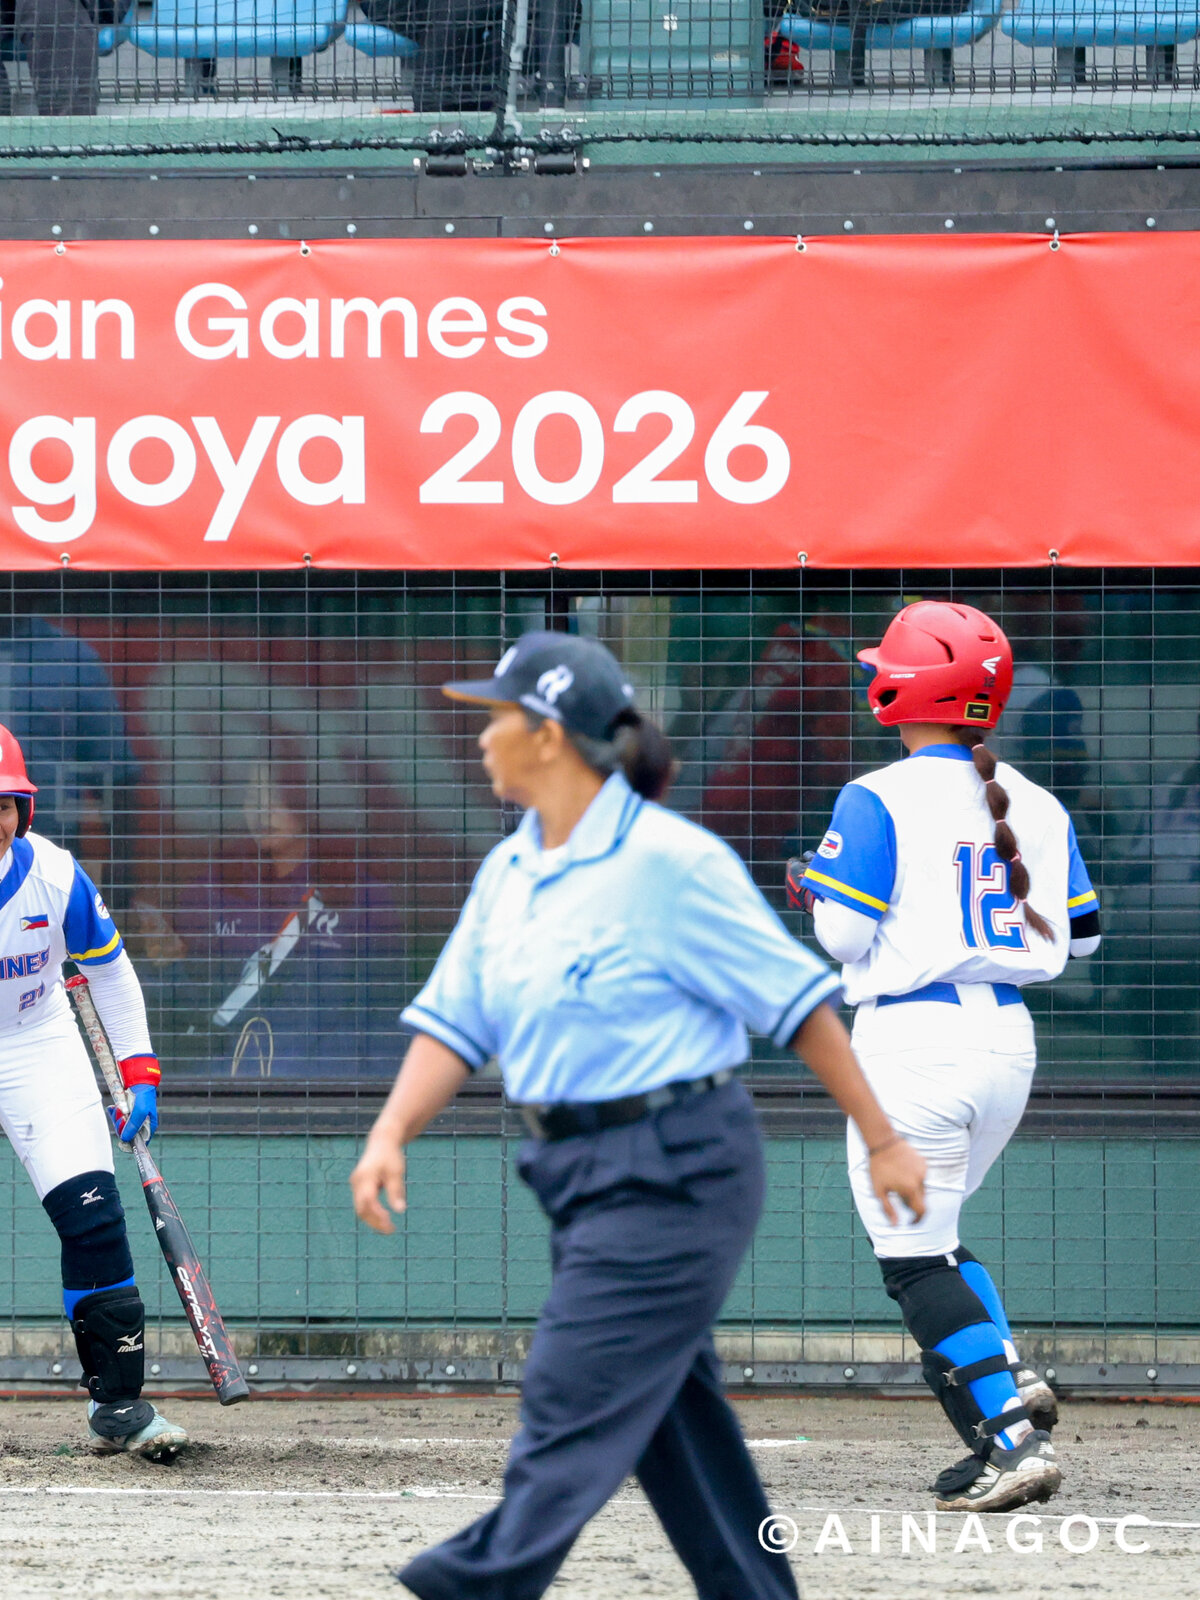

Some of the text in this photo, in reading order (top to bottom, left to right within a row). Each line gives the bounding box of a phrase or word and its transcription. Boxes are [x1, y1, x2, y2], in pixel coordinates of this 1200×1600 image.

[175, 283, 548, 360] Games
[420, 390, 790, 505] 2026
[952, 841, 1030, 952] 12
